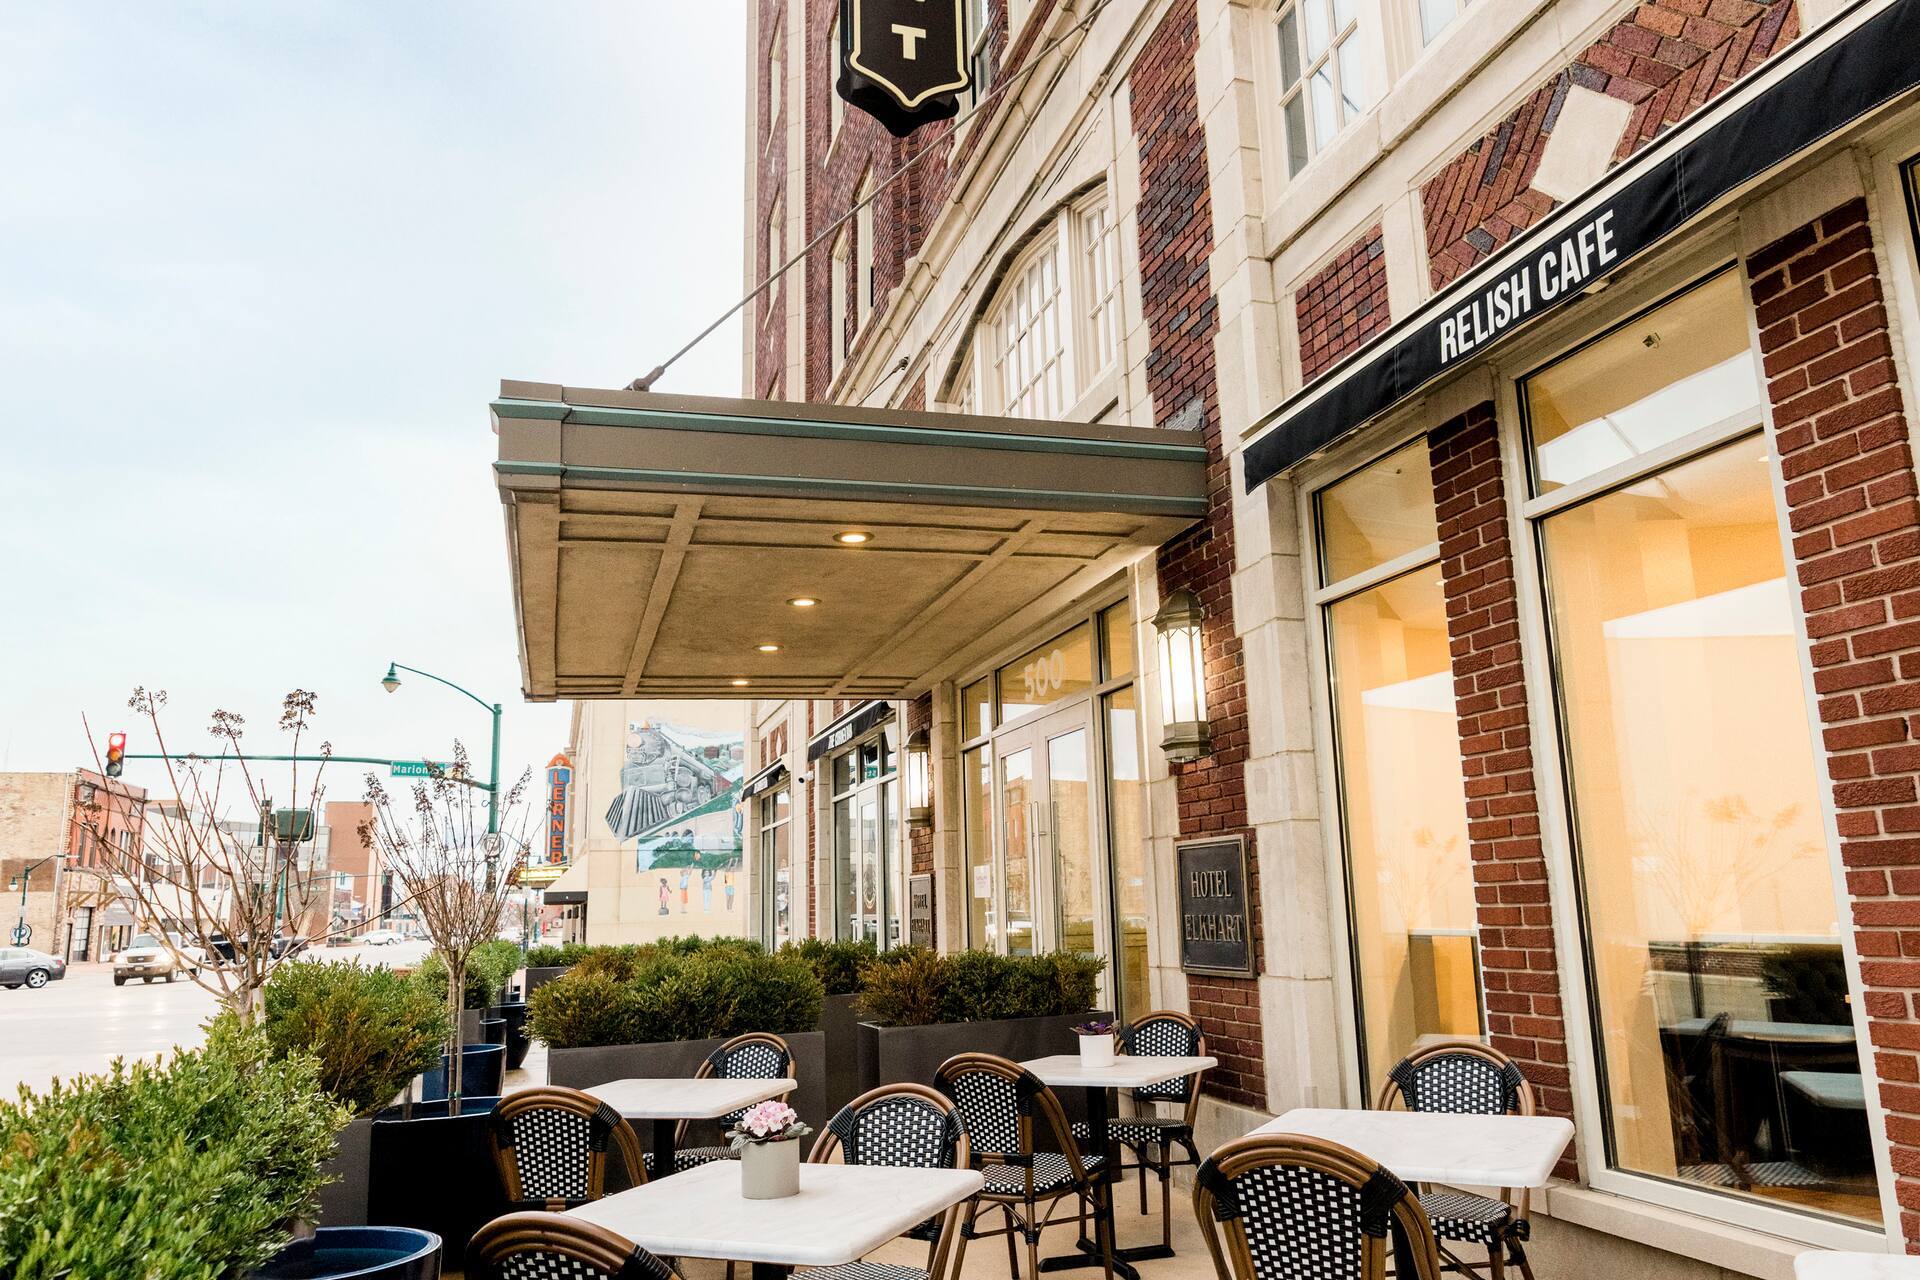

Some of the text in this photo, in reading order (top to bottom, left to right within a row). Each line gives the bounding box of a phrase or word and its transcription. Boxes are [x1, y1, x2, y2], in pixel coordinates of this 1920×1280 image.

[891, 0, 927, 60] T
[1440, 209, 1618, 364] RELISH CAFE
[1024, 649, 1064, 702] 500
[393, 765, 428, 774] Marion
[550, 769, 566, 864] LERNER
[1190, 869, 1232, 898] HOTEL
[1184, 914, 1242, 942] ELKHART
